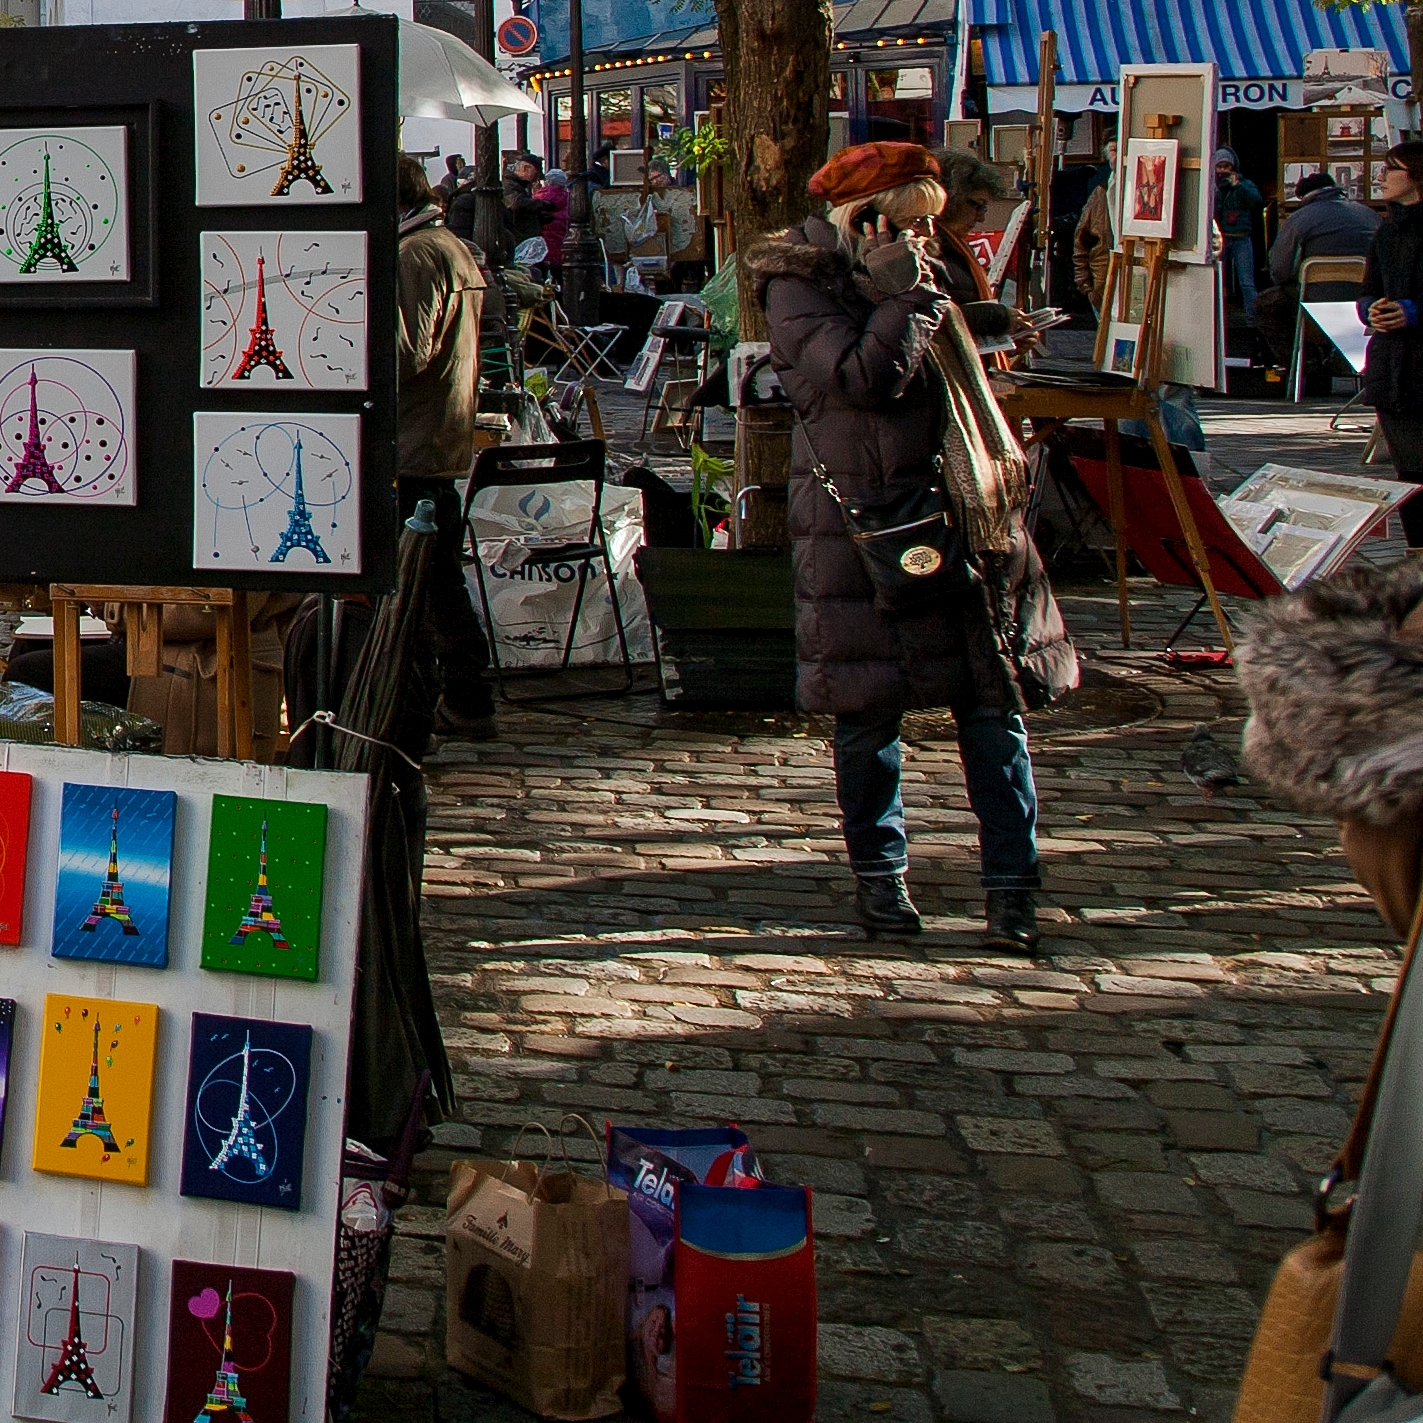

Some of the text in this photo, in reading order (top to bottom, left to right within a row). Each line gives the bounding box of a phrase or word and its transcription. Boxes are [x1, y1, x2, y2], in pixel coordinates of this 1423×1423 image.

[1221, 82, 1289, 103] RON
[462, 1214, 530, 1263] Famille Mary
